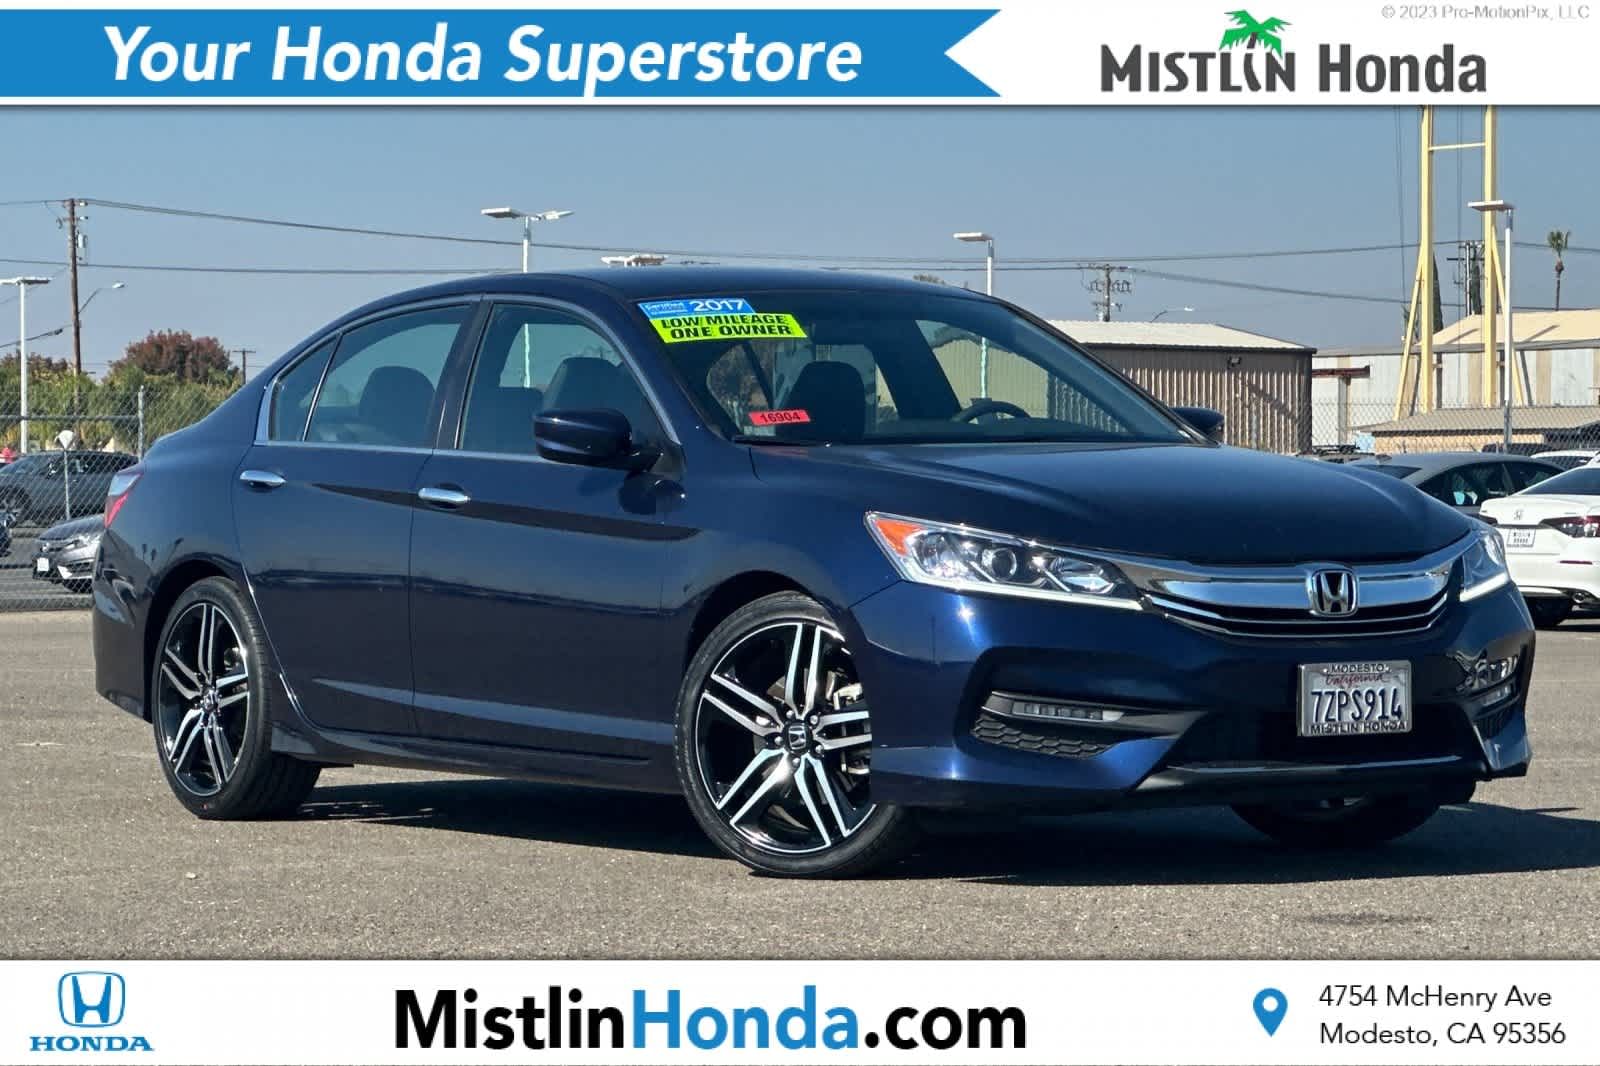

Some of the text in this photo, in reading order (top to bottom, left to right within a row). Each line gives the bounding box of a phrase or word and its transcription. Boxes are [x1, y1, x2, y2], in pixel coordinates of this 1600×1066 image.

[690, 300, 743, 312] 2017
[661, 314, 786, 329] LOW MILEAGE
[671, 324, 793, 339] ONE OWNER
[760, 411, 801, 422] 16904
[1331, 664, 1384, 673] MODESTO
[1311, 688, 1402, 722] 7ZPS914
[1311, 721, 1406, 734] MISTLIN HONDA
